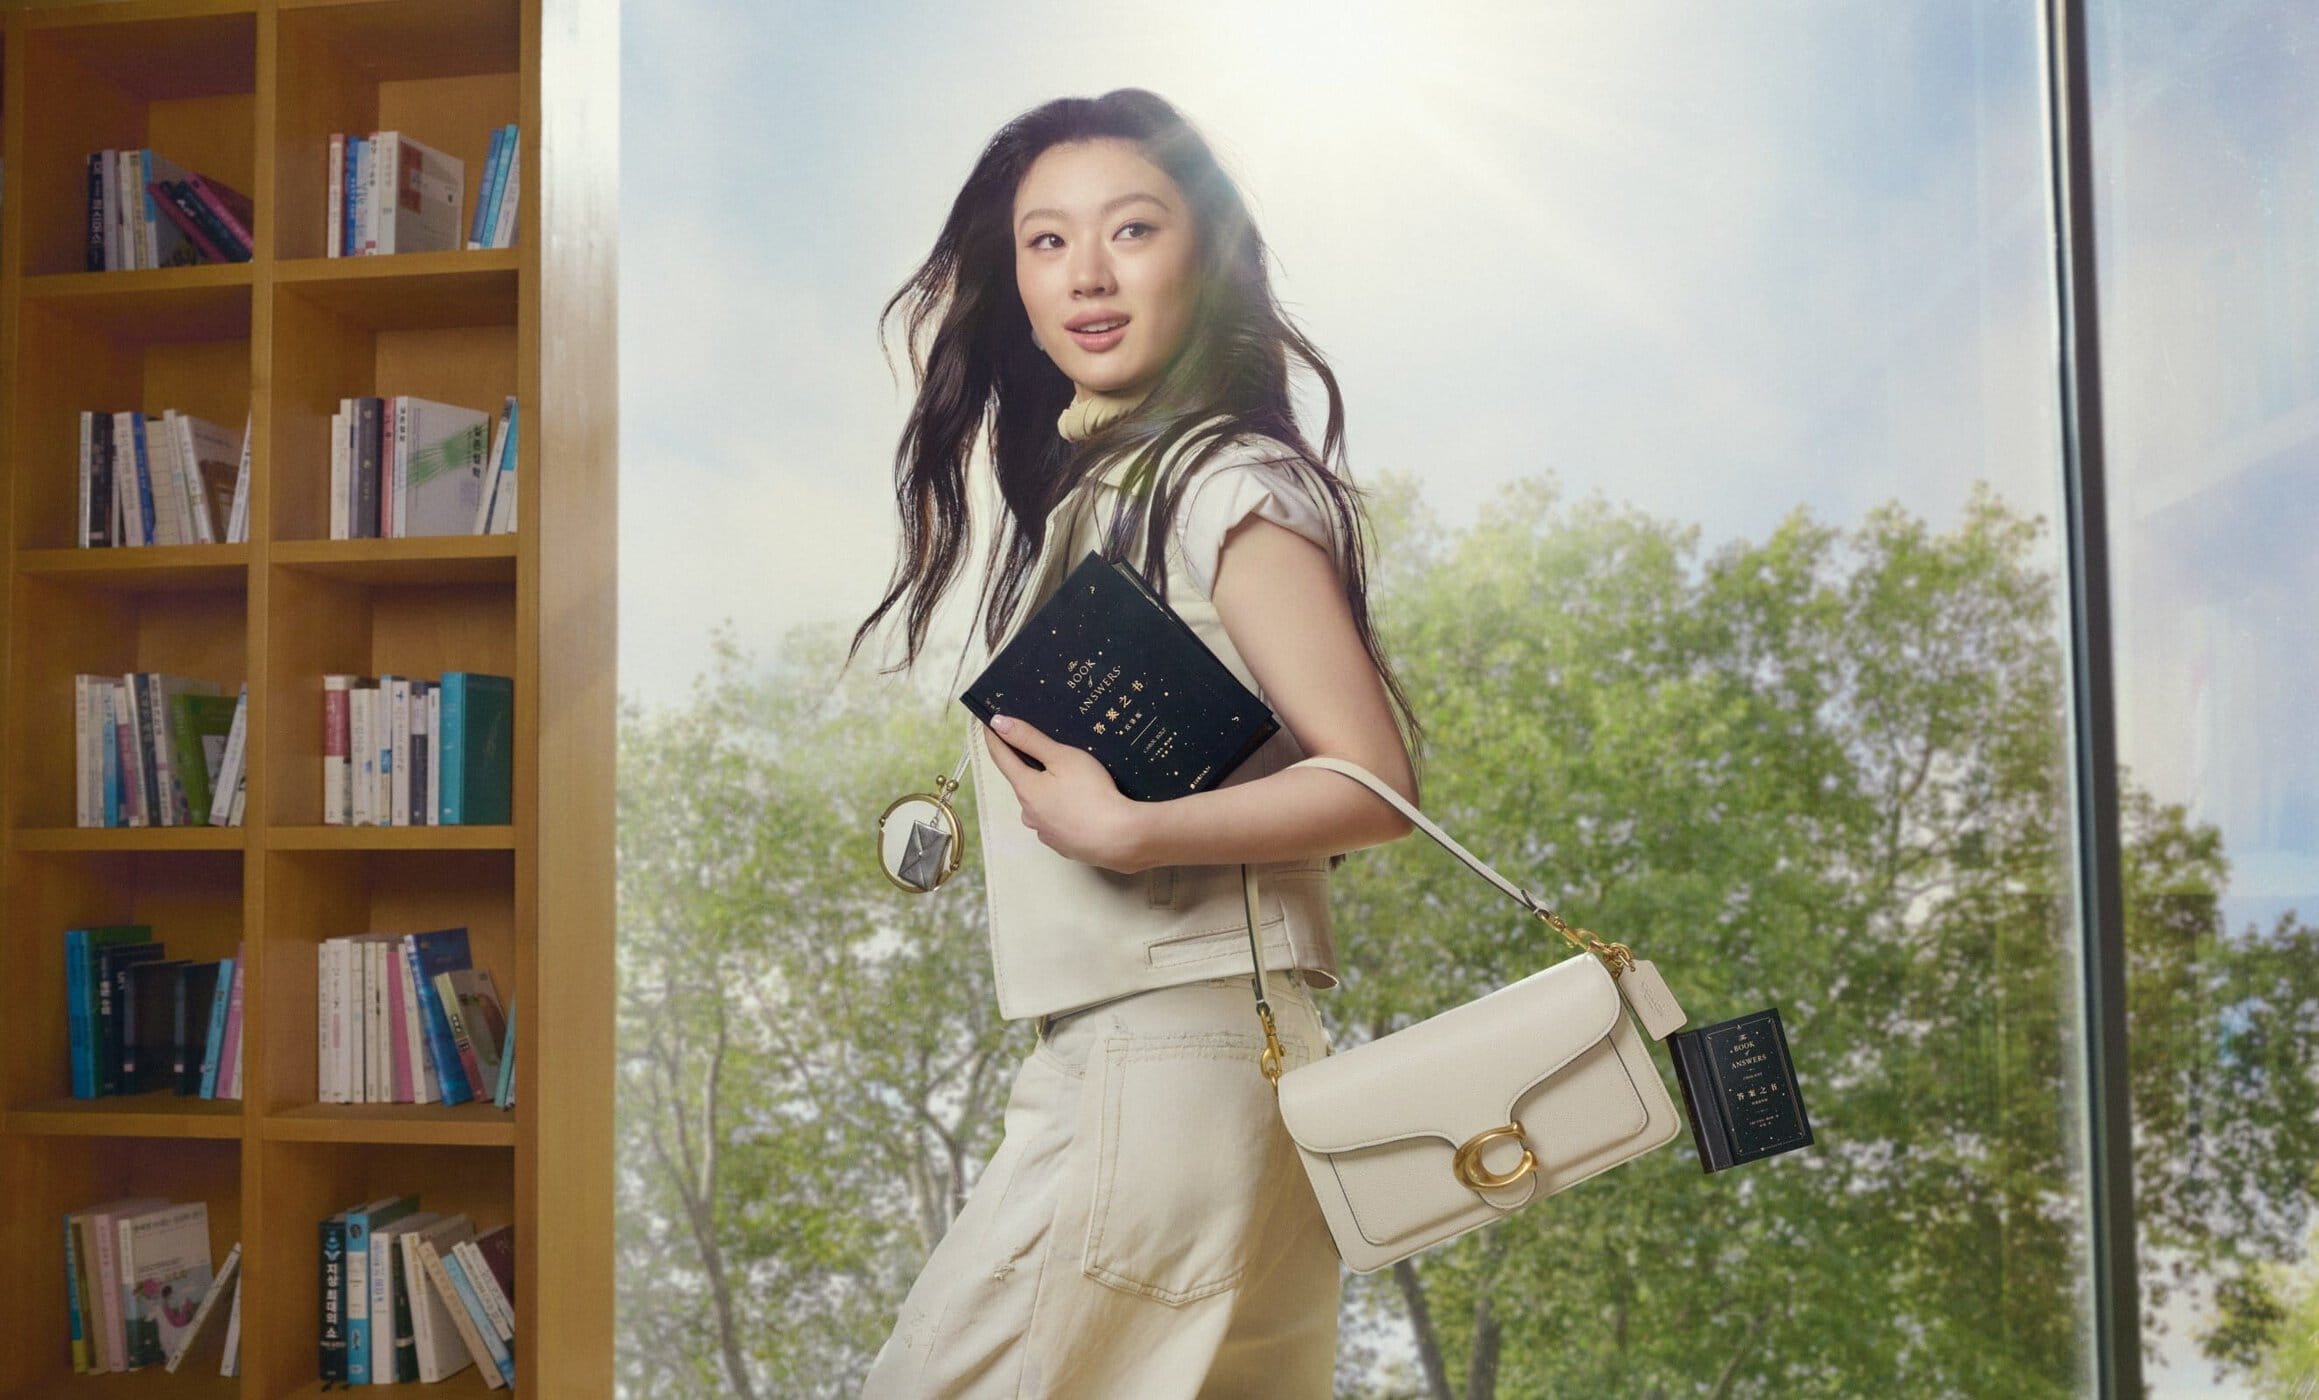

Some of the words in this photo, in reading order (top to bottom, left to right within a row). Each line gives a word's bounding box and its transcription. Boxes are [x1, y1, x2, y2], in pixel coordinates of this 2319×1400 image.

[1066, 659, 1096, 689] BOOK
[1079, 667, 1120, 715] ANSWERS
[1093, 680, 1144, 735] 答案之书
[1731, 1053, 1767, 1070] ANSWERS
[1733, 1041, 1756, 1052] BOOK
